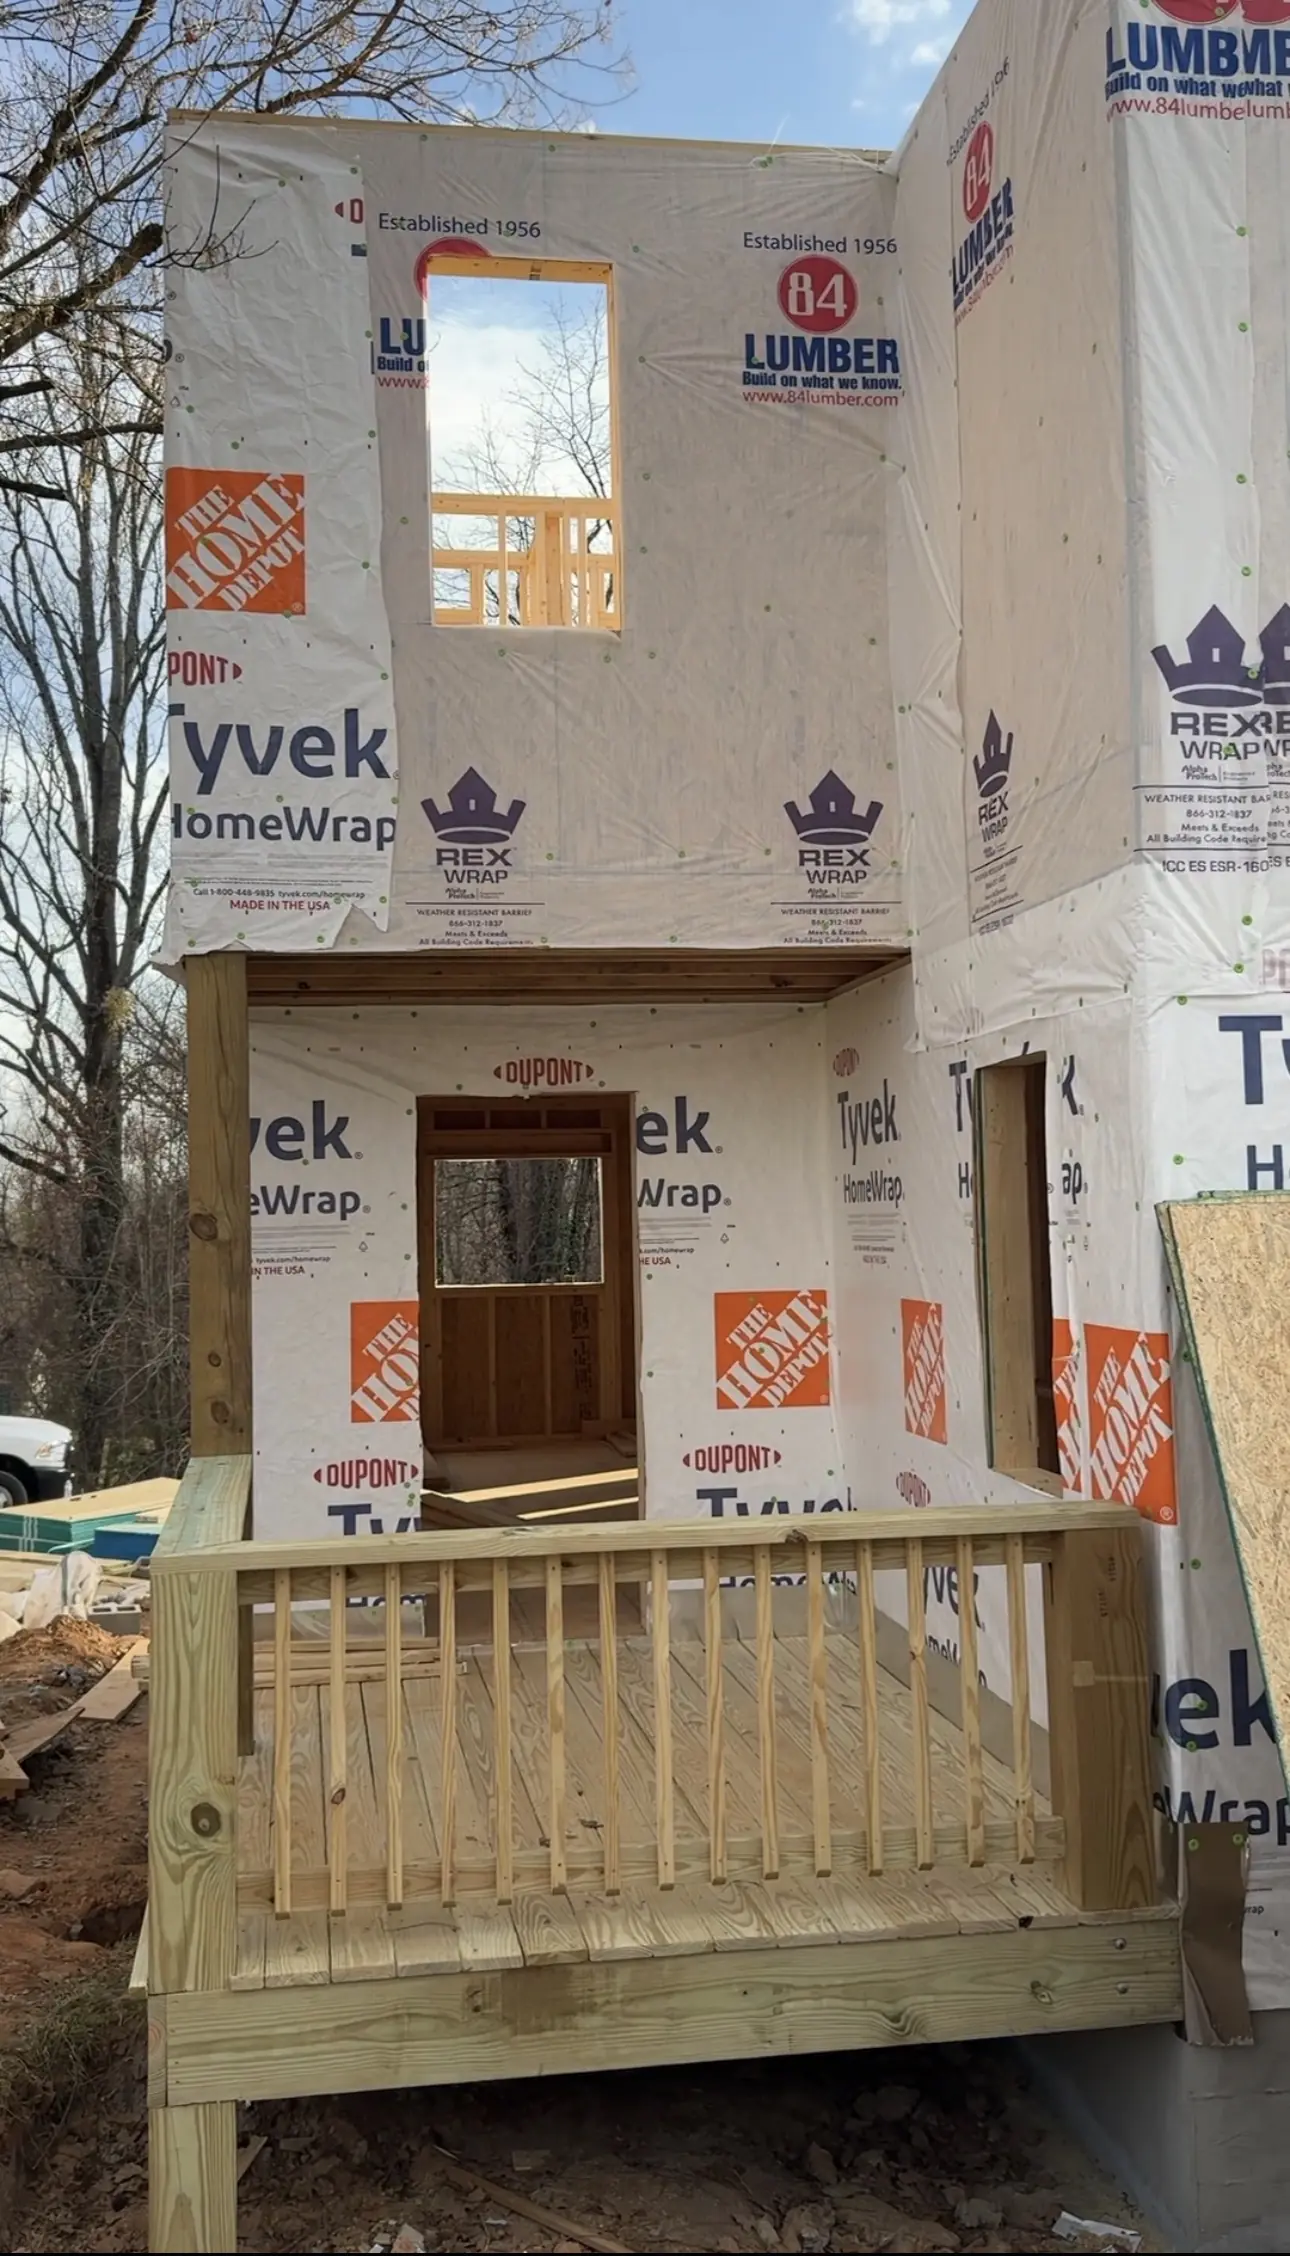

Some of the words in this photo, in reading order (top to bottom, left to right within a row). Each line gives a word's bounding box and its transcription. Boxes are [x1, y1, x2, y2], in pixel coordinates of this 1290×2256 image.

[1147, 76, 1169, 92] on
[1174, 78, 1217, 97] what
[378, 212, 489, 235] Established
[496, 219, 541, 238] 1956
[952, 177, 1014, 298] LUMBER
[743, 231, 847, 253] Established
[854, 238, 898, 255] 1956
[787, 271, 848, 318] 84
[377, 356, 413, 373] Build
[745, 334, 900, 374] LUMBER
[742, 371, 776, 386] Build
[780, 375, 797, 387] on
[802, 374, 834, 389] what
[839, 377, 858, 390] we
[862, 375, 902, 390] know.
[743, 389, 899, 407] www.84lumber.com
[174, 484, 235, 541] THE
[166, 473, 306, 611] HOME
[217, 525, 305, 612] DEPOT
[1170, 711, 1264, 738] REX
[1180, 740, 1261, 761] WRAP
[978, 790, 1009, 826] REX
[1144, 794, 1194, 803] WEATHER
[1198, 795, 1247, 804] RESISTANT
[1186, 809, 1253, 819] 866-312-1837
[981, 816, 1008, 843] WRAP
[1147, 834, 1161, 843] All
[1164, 834, 1202, 845] Building
[1204, 834, 1229, 843] Code
[1181, 823, 1209, 832] Meets
[1211, 823, 1218, 832] &
[1222, 823, 1259, 833] Exceeds
[436, 848, 513, 867] REX
[799, 849, 871, 867] REX
[1189, 860, 1207, 873] ES
[444, 870, 508, 884] WRAP
[806, 870, 868, 884] WRAP
[193, 888, 209, 896] Call
[210, 888, 275, 898] 1-800-448-9835
[230, 899, 265, 911] MADE
[268, 900, 279, 910] IN
[284, 901, 305, 911] THE
[309, 901, 331, 912] USA
[416, 908, 456, 917] WEATHER
[458, 908, 499, 917] RESISTANT
[780, 907, 817, 915] WEATHER
[506, 1057, 583, 1087] DUPONT
[837, 1078, 898, 1166] Tyvek
[843, 1170, 902, 1209] HomeWrap
[263, 1266, 283, 1275] THE
[285, 1265, 305, 1275] USA
[651, 1256, 672, 1265] USA
[363, 1312, 414, 1363] THE
[726, 1303, 774, 1351] THE
[716, 1289, 829, 1409] HOME
[761, 1330, 834, 1408] DEPOT
[1093, 1345, 1122, 1415] THE
[1090, 1332, 1171, 1501] HOME
[694, 1444, 772, 1474] DUPONT
[1118, 1402, 1174, 1507] DEPOT
[326, 1458, 408, 1489] DUPONT
